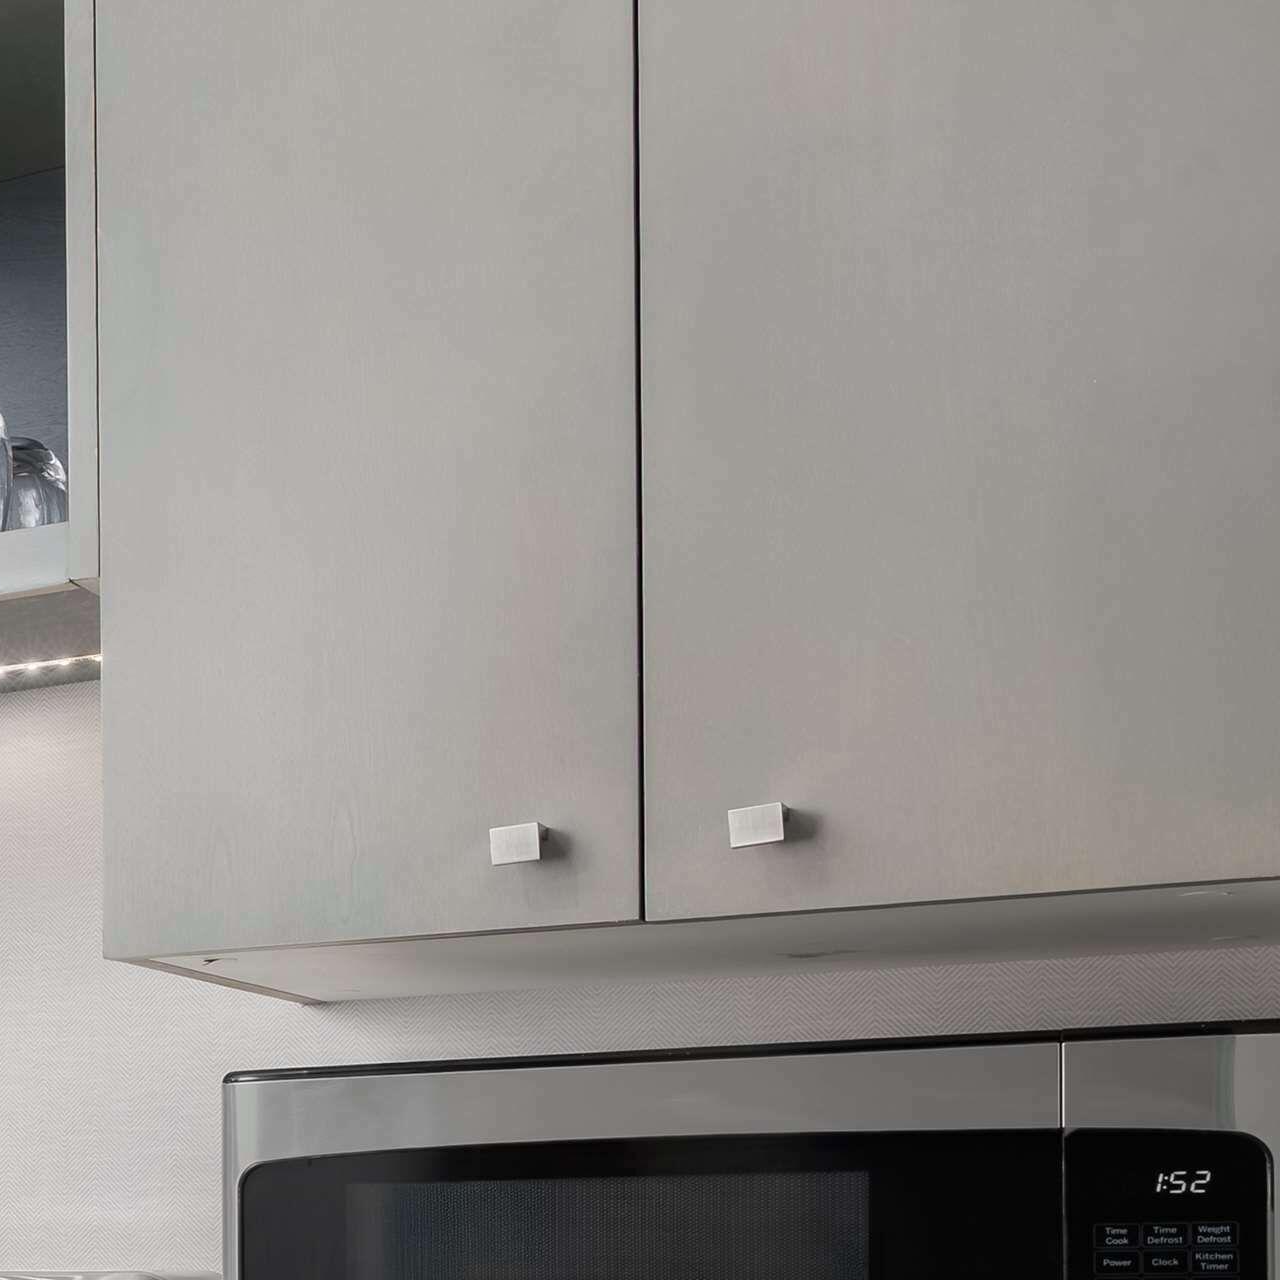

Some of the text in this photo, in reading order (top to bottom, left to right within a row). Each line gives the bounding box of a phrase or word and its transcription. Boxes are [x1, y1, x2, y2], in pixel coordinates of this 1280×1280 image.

[1155, 1170, 1212, 1194] 1:52
[1105, 1227, 1128, 1235] Time
[1153, 1226, 1177, 1234] Time
[1198, 1225, 1230, 1235] Weight
[1105, 1236, 1129, 1245] Cook
[1147, 1235, 1183, 1244] Defrost
[1197, 1235, 1232, 1244] Defrost
[1195, 1252, 1233, 1261] Kitchen
[1103, 1258, 1132, 1267] Power
[1151, 1258, 1179, 1267] Clock
[1200, 1262, 1228, 1271] Timer
